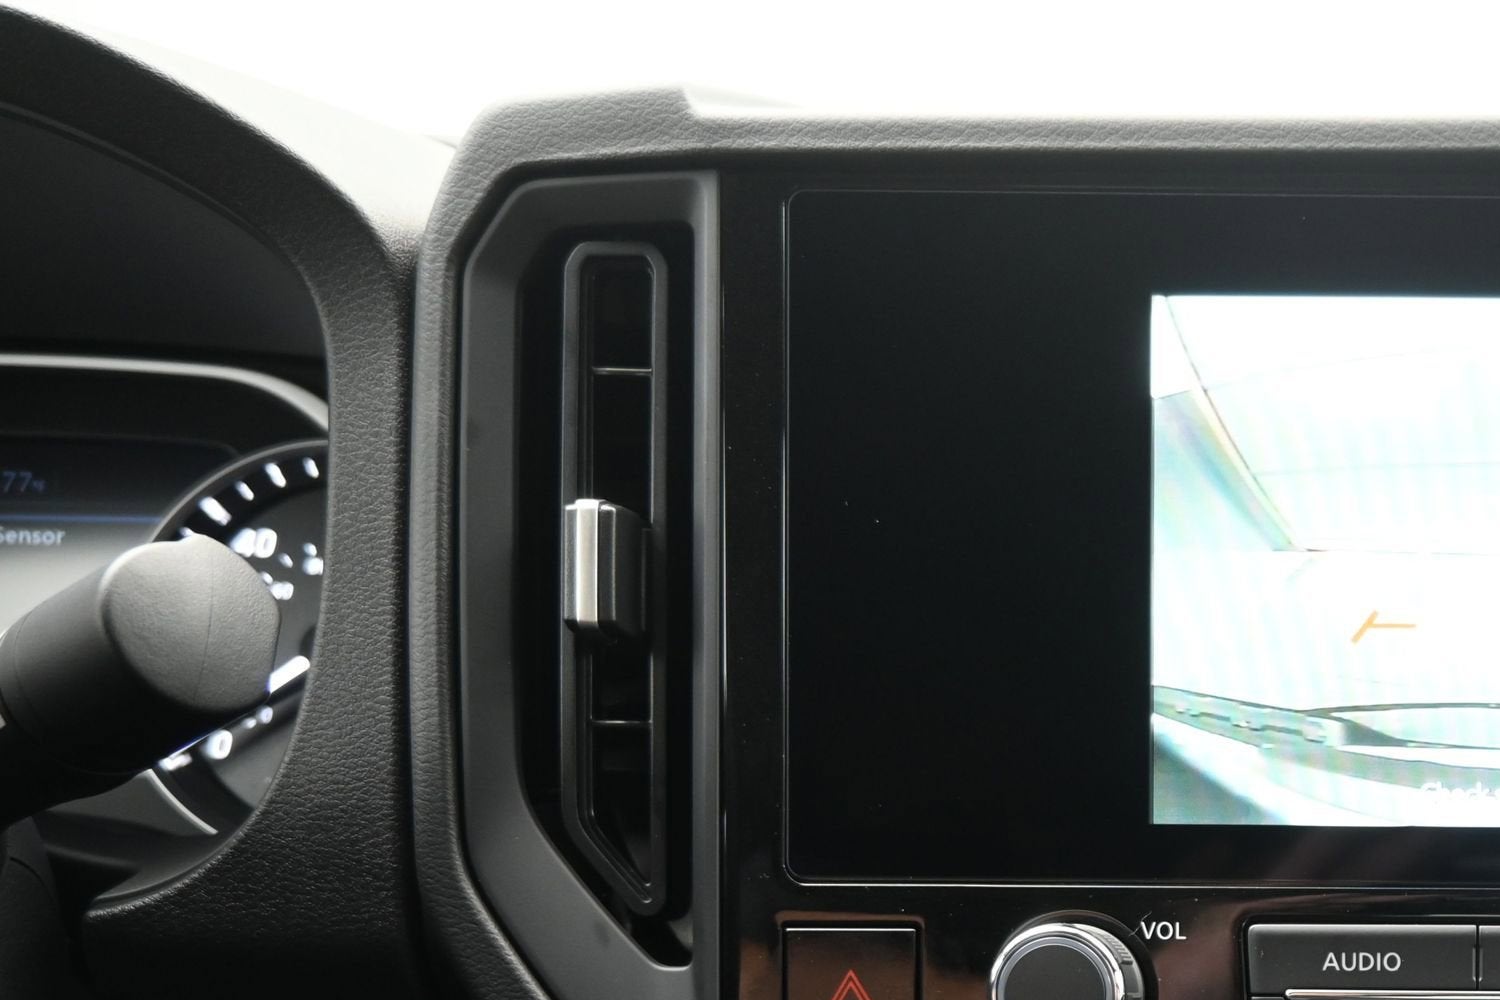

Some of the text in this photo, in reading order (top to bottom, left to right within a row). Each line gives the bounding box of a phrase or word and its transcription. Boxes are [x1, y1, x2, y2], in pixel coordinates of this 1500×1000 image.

[1420, 781, 1490, 804] Check
[1140, 921, 1187, 940] VOL
[1322, 951, 1402, 972] AUDIO
